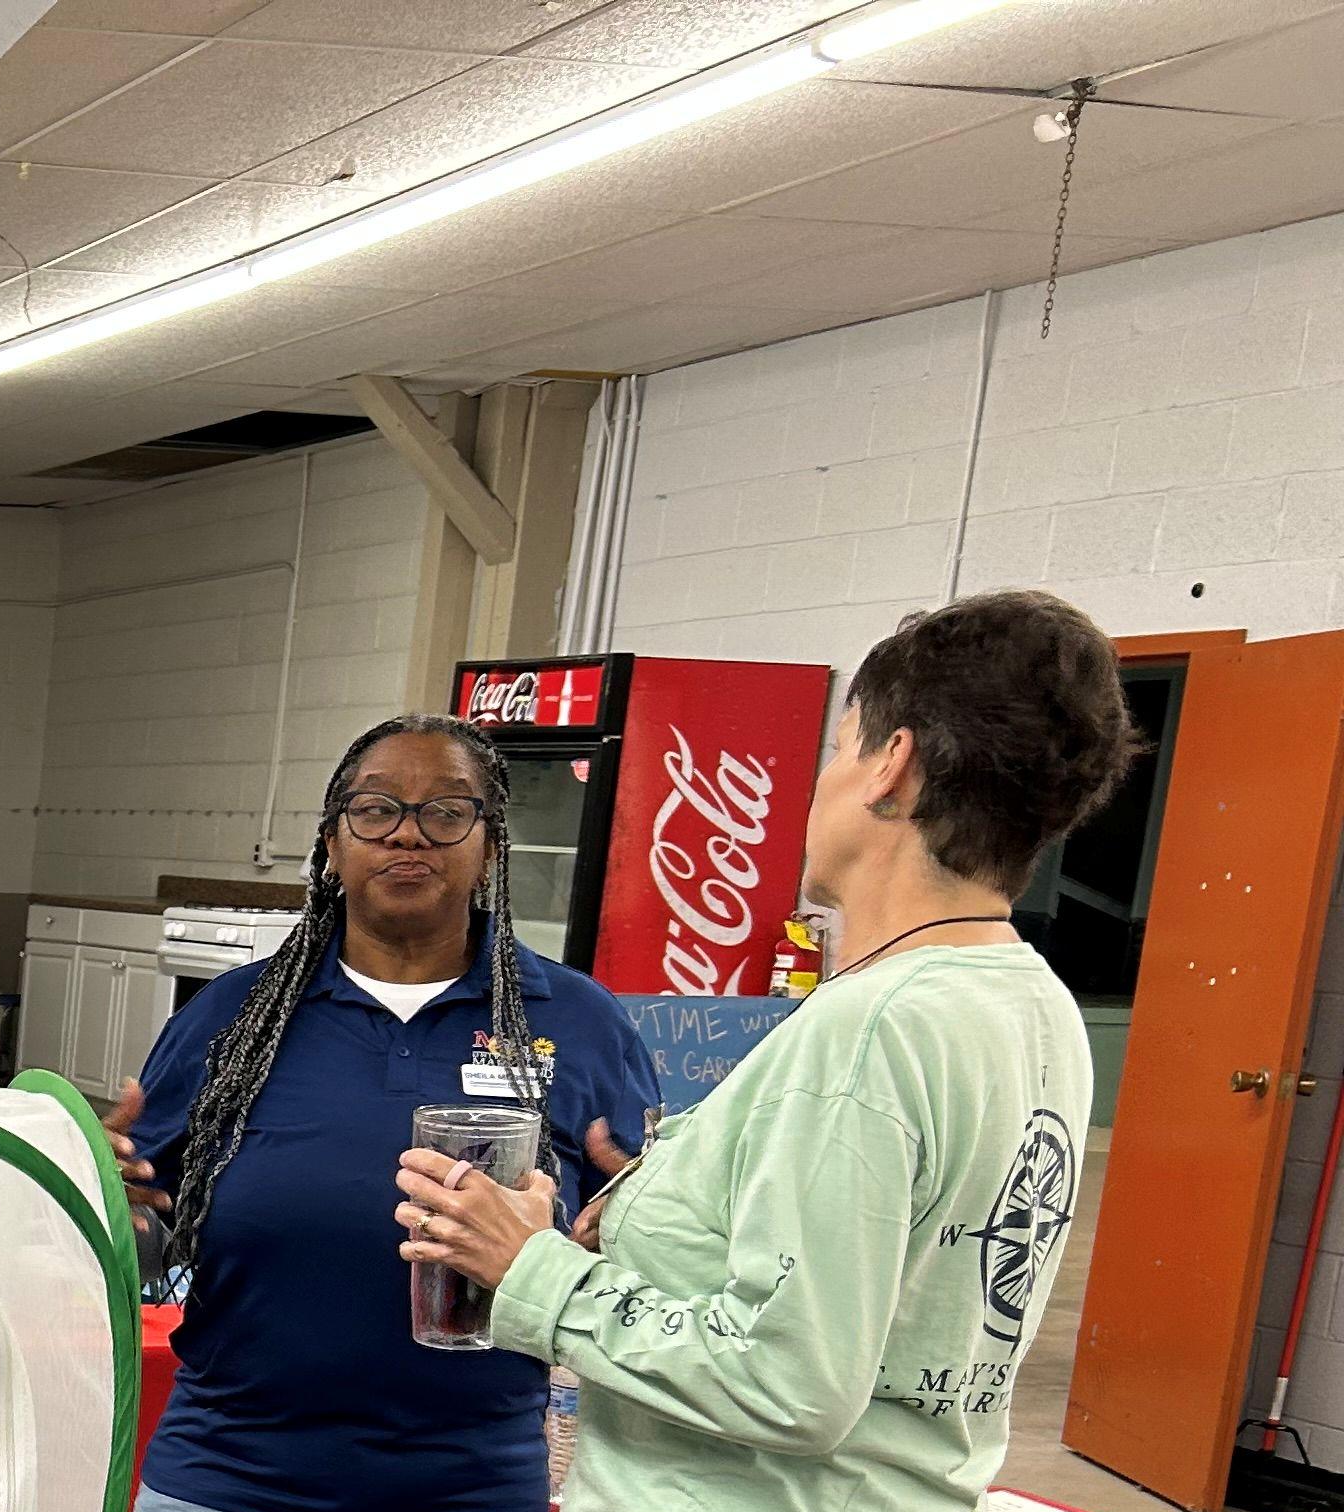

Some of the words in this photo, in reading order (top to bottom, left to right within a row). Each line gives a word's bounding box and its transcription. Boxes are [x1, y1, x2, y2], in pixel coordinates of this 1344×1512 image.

[624, 1000, 729, 1044] YTIME
[739, 1010, 790, 1035] WIT
[937, 1222, 966, 1248] W
